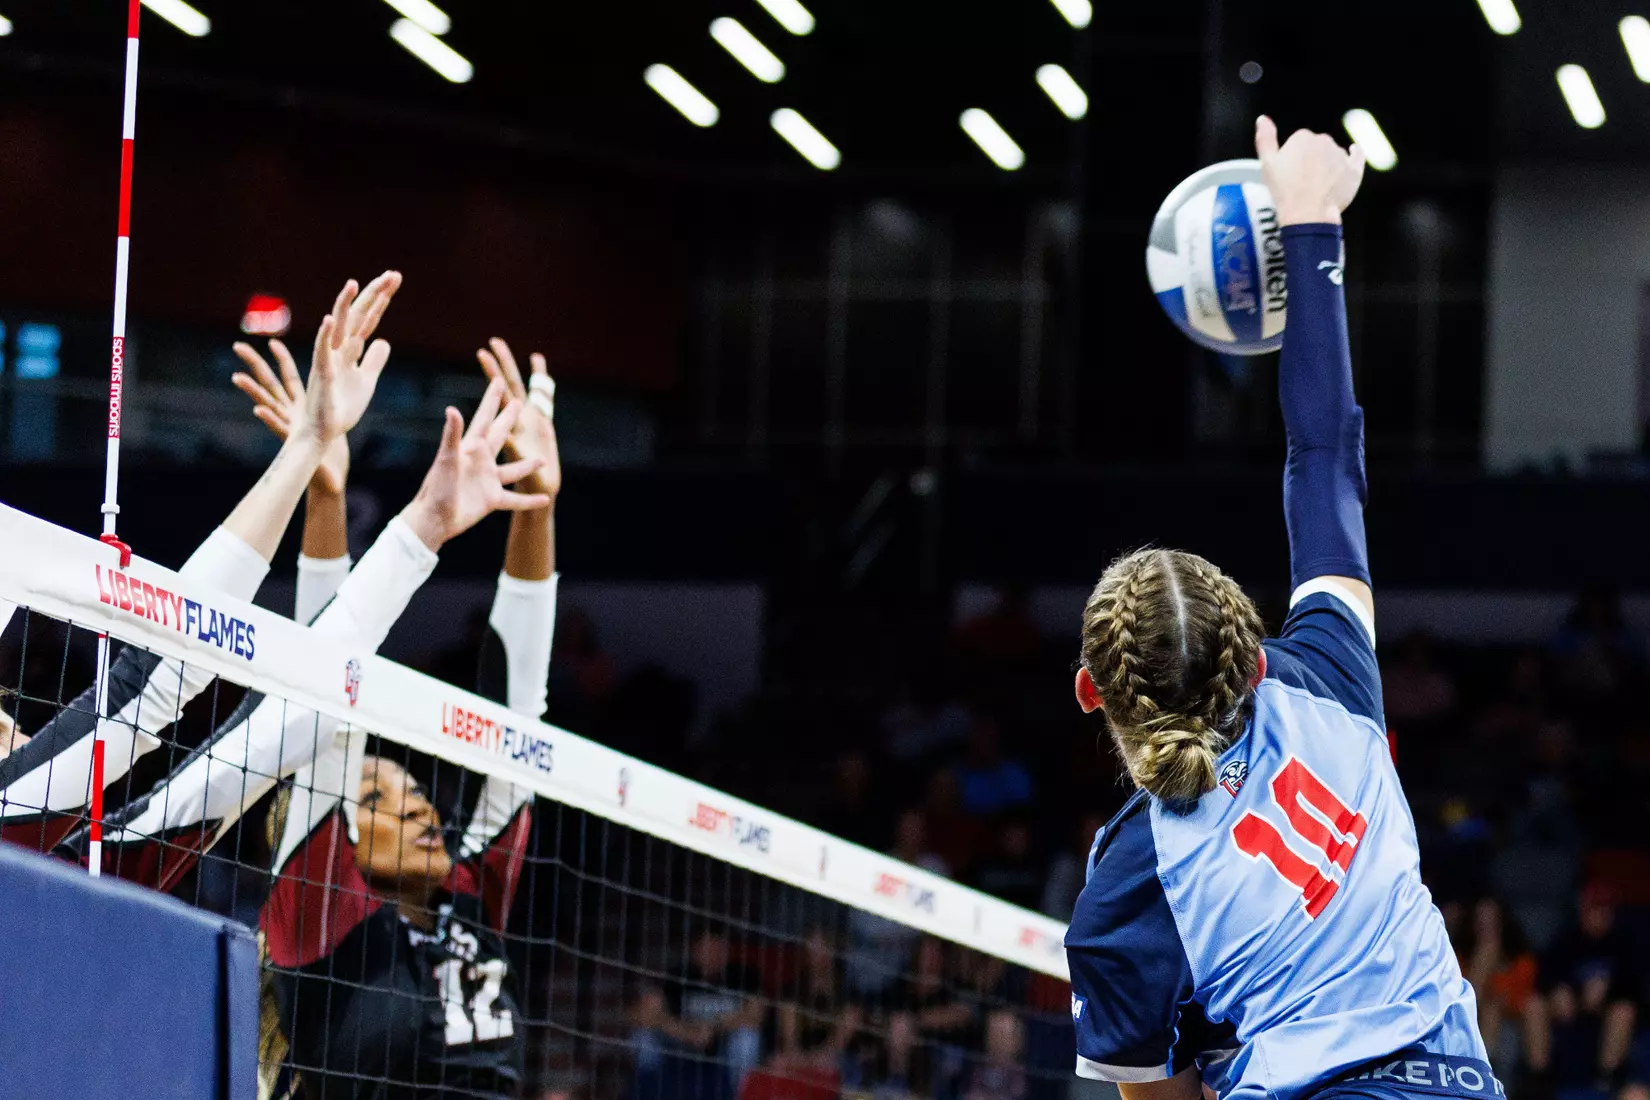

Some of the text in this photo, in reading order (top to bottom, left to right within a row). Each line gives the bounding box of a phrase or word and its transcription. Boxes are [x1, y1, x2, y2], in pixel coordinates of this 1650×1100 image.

[111, 337, 123, 383] sports
[433, 958, 514, 1046] 12
[1343, 1060, 1432, 1086] KE
